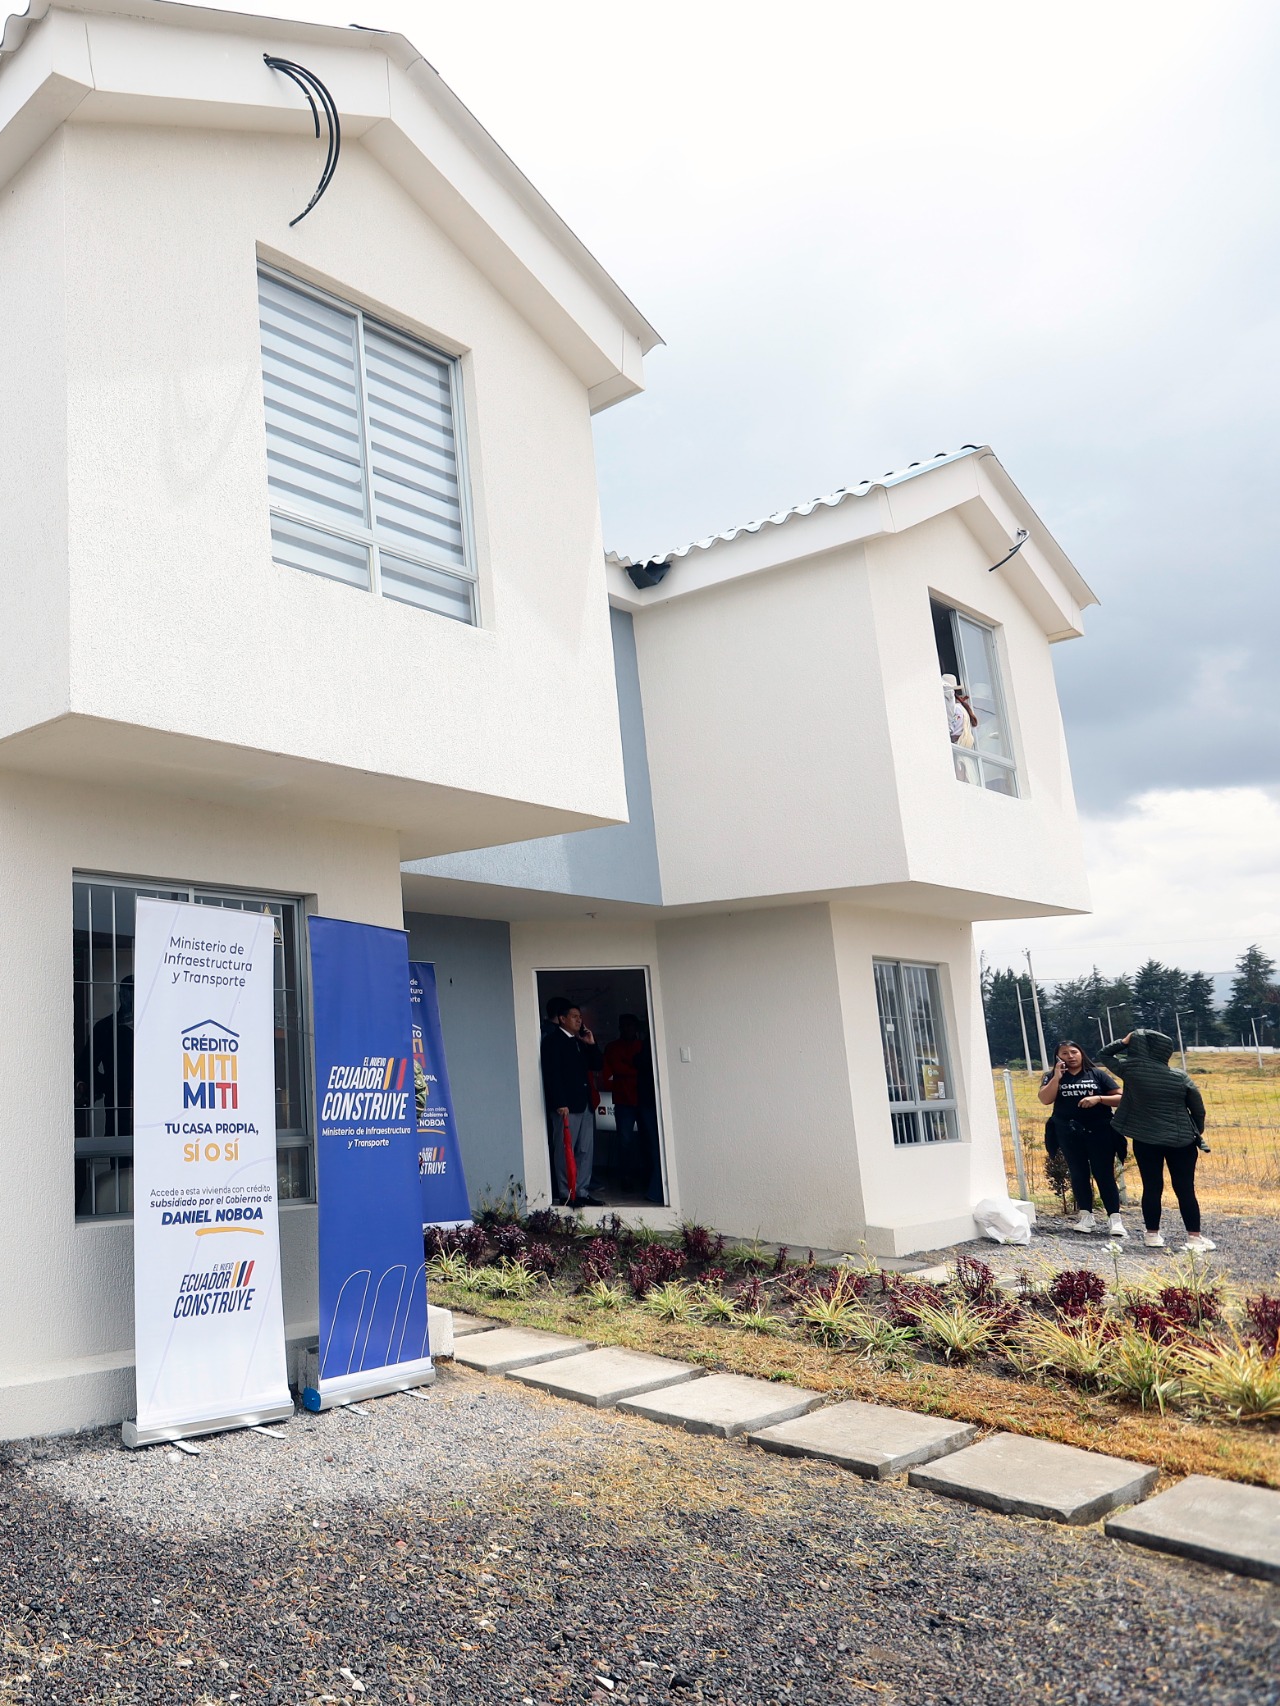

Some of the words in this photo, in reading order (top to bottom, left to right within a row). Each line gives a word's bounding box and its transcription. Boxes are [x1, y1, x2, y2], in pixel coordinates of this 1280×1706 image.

[169, 936, 227, 953] Ministerio
[229, 943, 244, 955] de
[163, 952, 252, 972] Infraestructura
[171, 971, 181, 984] y
[183, 970, 246, 988] Transporte
[182, 1034, 239, 1053] CRÉDITO
[183, 1053, 237, 1081] MITI
[363, 1057, 370, 1066] EL
[370, 1057, 387, 1067] NUEVO
[327, 1066, 384, 1090] ECUADOR
[183, 1082, 238, 1109] MITI
[321, 1092, 409, 1121] CONSTRUYE
[164, 1123, 180, 1134] TU
[182, 1123, 213, 1134] CASA
[215, 1123, 259, 1135] PROPIA,
[321, 1127, 355, 1136] Ministerio
[356, 1127, 365, 1135] de
[366, 1126, 411, 1135] Infraestructura
[420, 1119, 445, 1127] NOBOA
[183, 1138, 200, 1162] SÍ
[204, 1142, 220, 1162] O
[224, 1138, 240, 1161] SÍ
[348, 1140, 353, 1149] y
[354, 1139, 389, 1148] Transporte
[420, 1161, 446, 1175] STRUYE
[150, 1187, 179, 1197] Accede
[180, 1188, 185, 1196] a
[185, 1187, 201, 1196] esta
[202, 1185, 231, 1195] vivienda
[232, 1186, 245, 1194] con
[246, 1184, 271, 1193] crédito
[150, 1197, 197, 1208] subsidiado
[199, 1197, 214, 1208] por
[216, 1196, 224, 1205] el
[225, 1195, 262, 1204] Gobierno
[263, 1194, 273, 1203] de
[161, 1210, 212, 1226] DANIEL
[215, 1207, 263, 1223] NOBOA
[213, 1263, 219, 1272] EL
[220, 1262, 234, 1271] NUEVO
[180, 1271, 232, 1293] ECUADOR
[173, 1288, 256, 1319] CONSTRUYE
